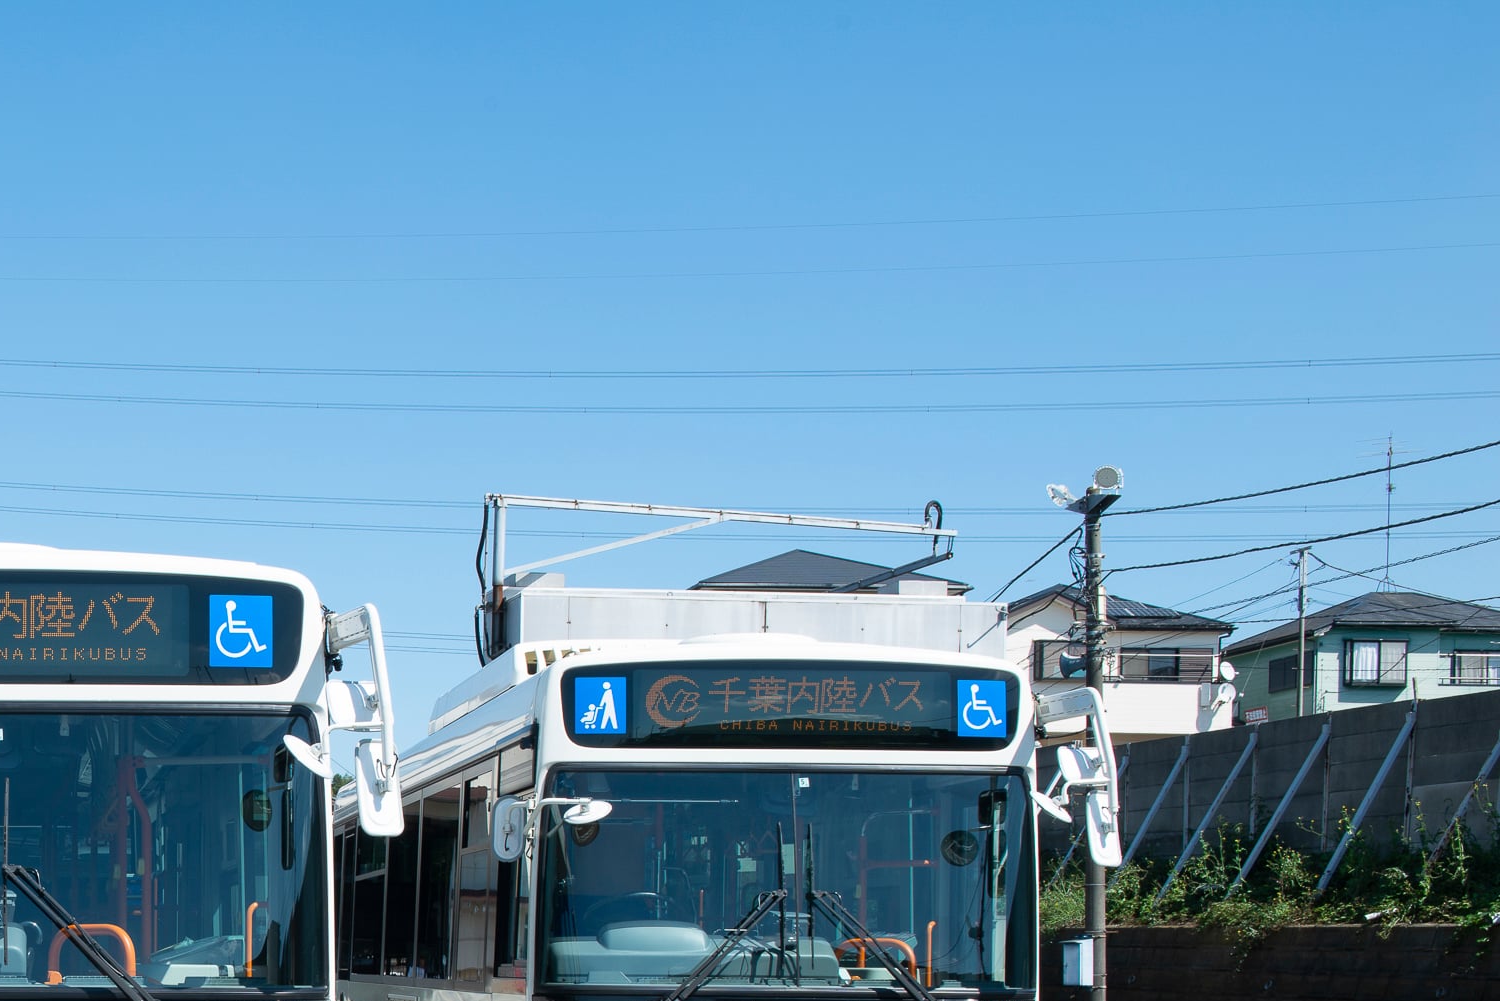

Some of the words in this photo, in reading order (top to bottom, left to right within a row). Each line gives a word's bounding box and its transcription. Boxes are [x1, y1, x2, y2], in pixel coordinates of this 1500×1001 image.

[708, 676, 924, 714] 千葉内陸バス
[720, 719, 779, 730] CHIBA
[793, 720, 912, 732] NAIRIKUBUS
